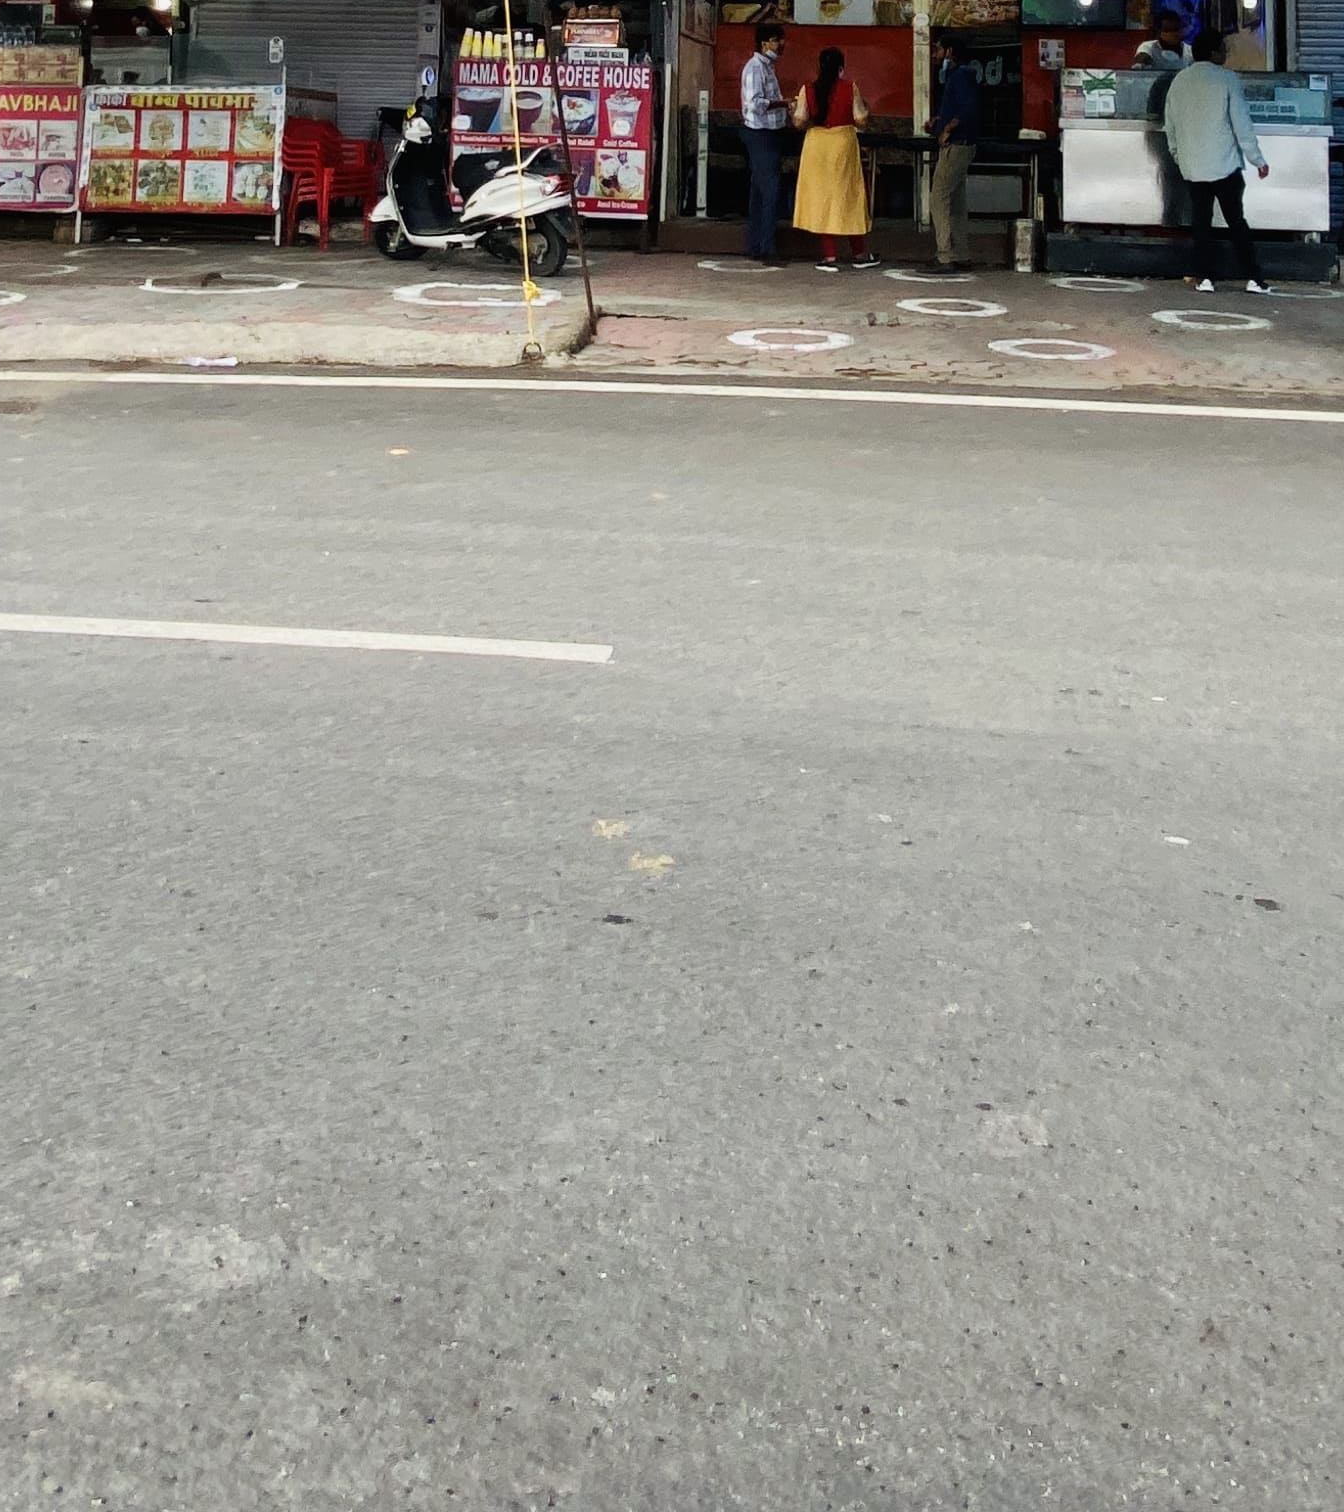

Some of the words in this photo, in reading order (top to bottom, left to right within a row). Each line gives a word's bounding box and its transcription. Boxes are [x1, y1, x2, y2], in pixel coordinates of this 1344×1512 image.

[458, 62, 500, 85] MAMA
[503, 63, 539, 86] COLD
[542, 65, 553, 86] &
[556, 66, 601, 89] COFEE
[603, 67, 651, 89] HOUSE
